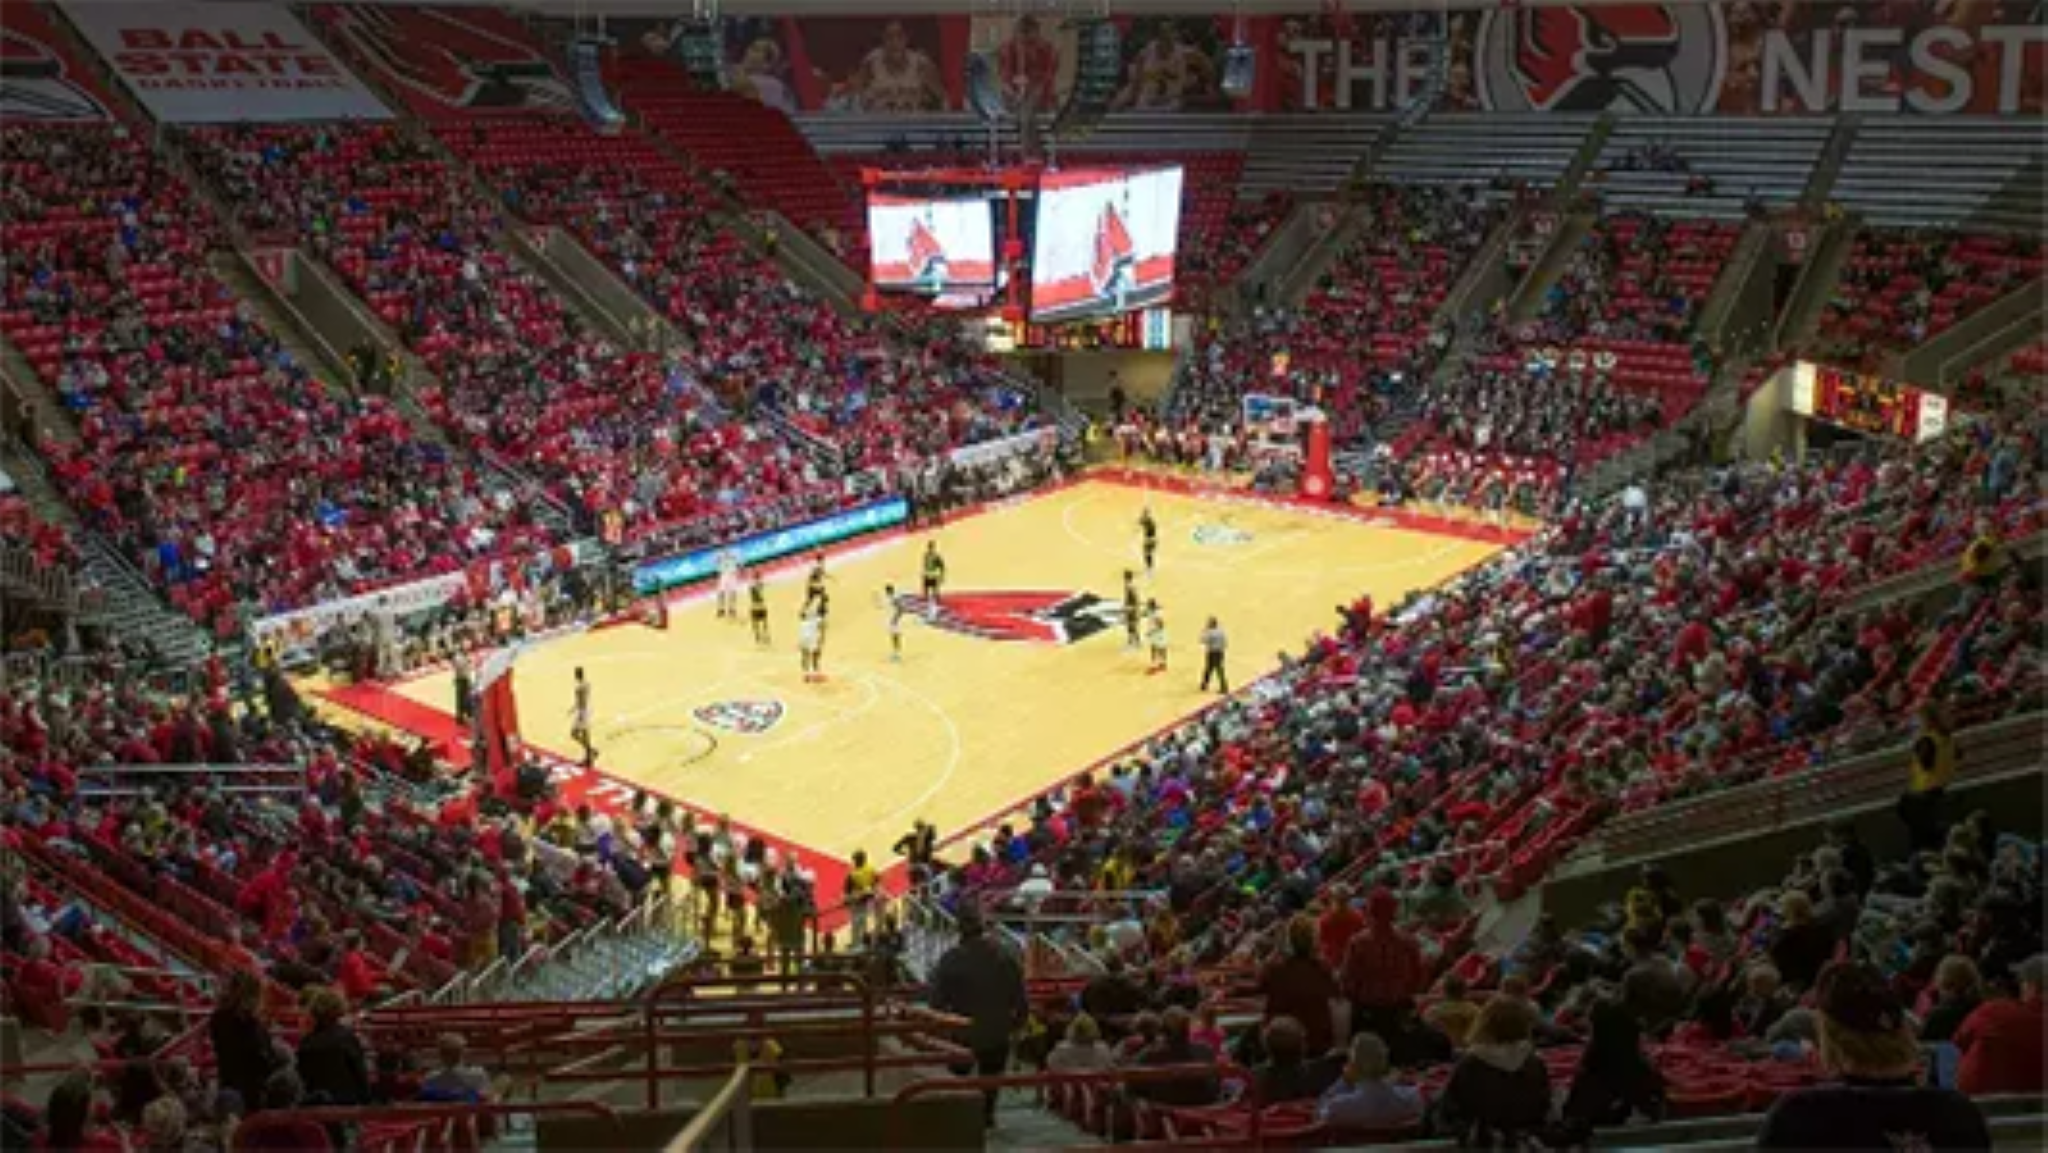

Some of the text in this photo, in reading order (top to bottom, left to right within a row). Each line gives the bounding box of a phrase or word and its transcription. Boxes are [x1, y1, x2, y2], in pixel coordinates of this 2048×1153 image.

[117, 28, 305, 49] BALL
[114, 51, 341, 75] STATE
[1289, 25, 2048, 114] THE NEST
[137, 77, 348, 90] BASKETBALL
